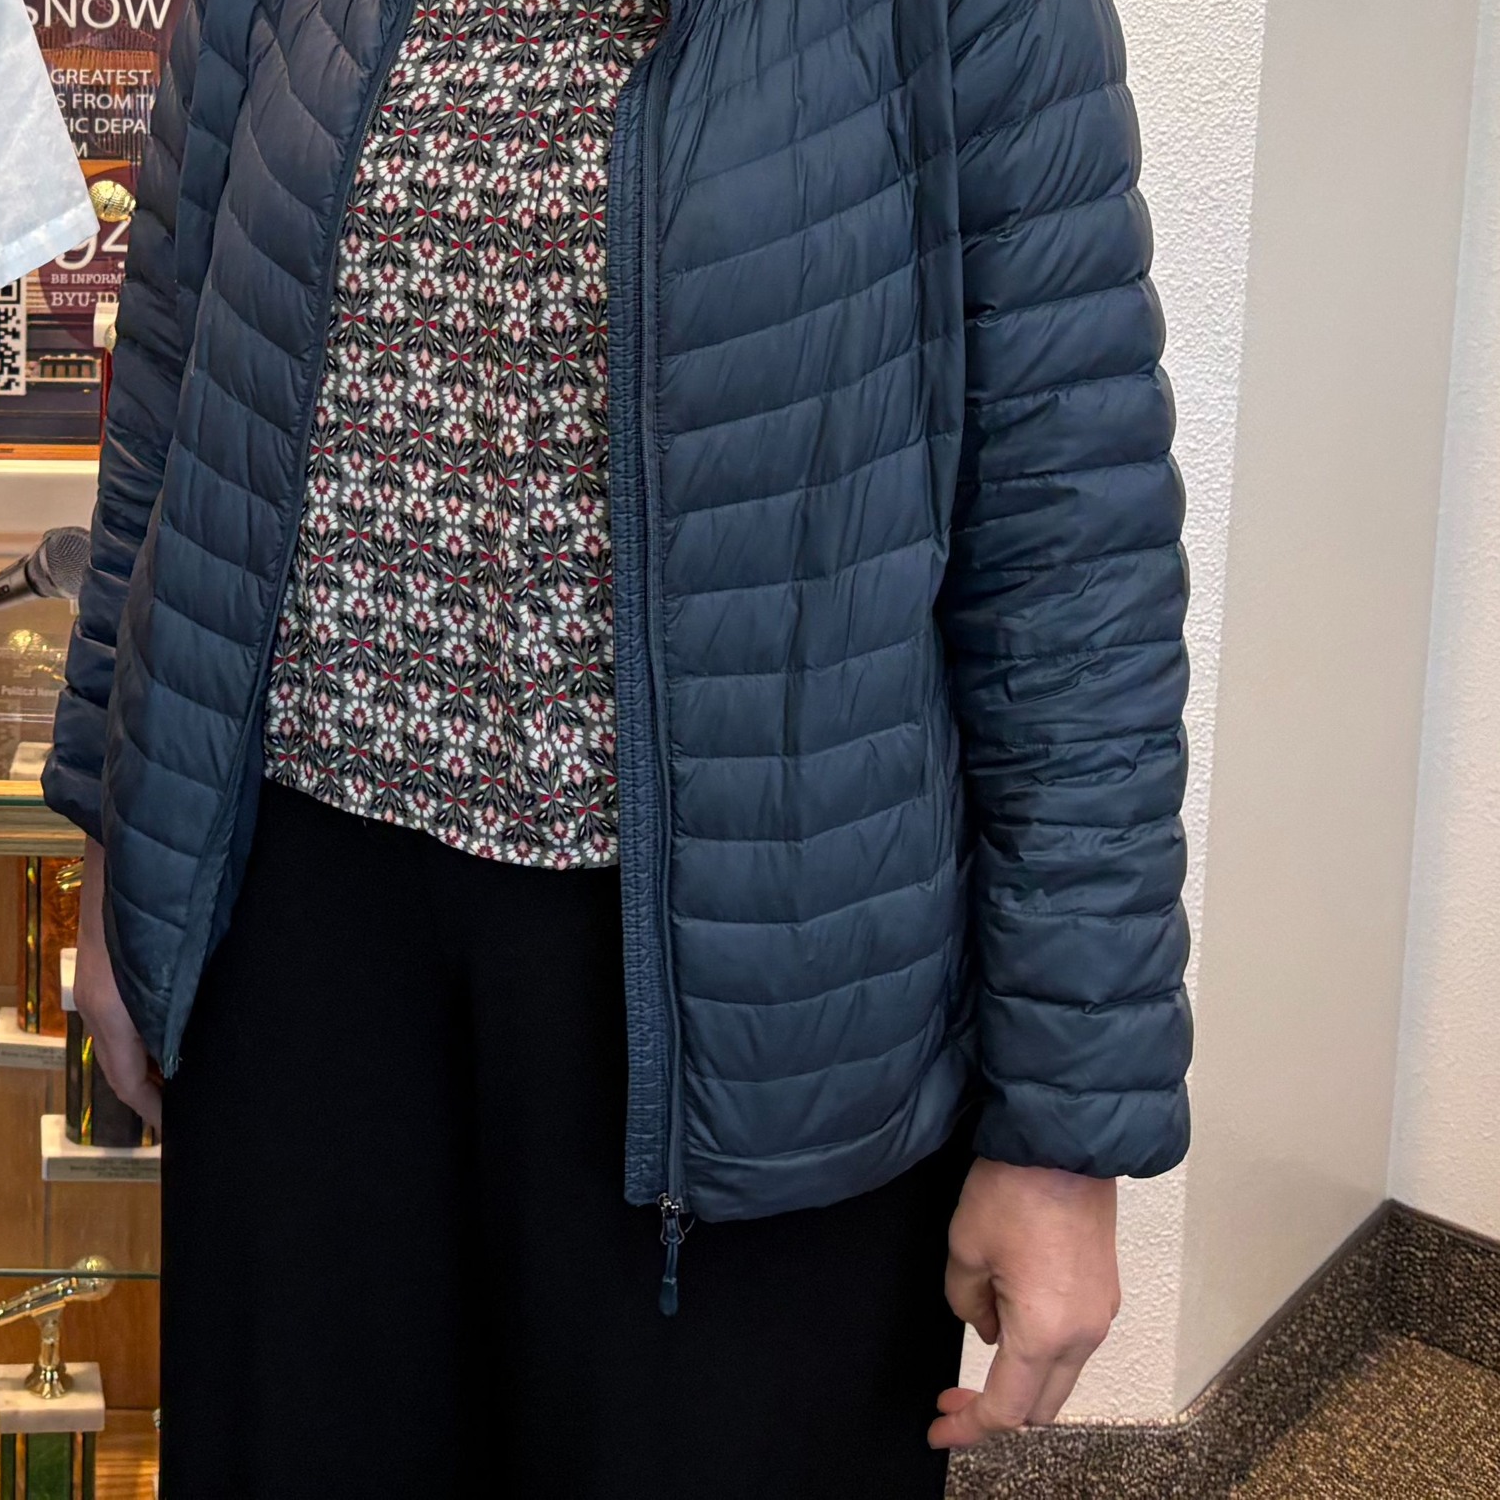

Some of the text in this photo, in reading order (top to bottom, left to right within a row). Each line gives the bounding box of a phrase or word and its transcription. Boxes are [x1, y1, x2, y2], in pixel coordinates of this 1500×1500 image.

[50, 68, 152, 86] GREATEST
[72, 93, 132, 110] FROM
[50, 273, 126, 285] BE INFORM
